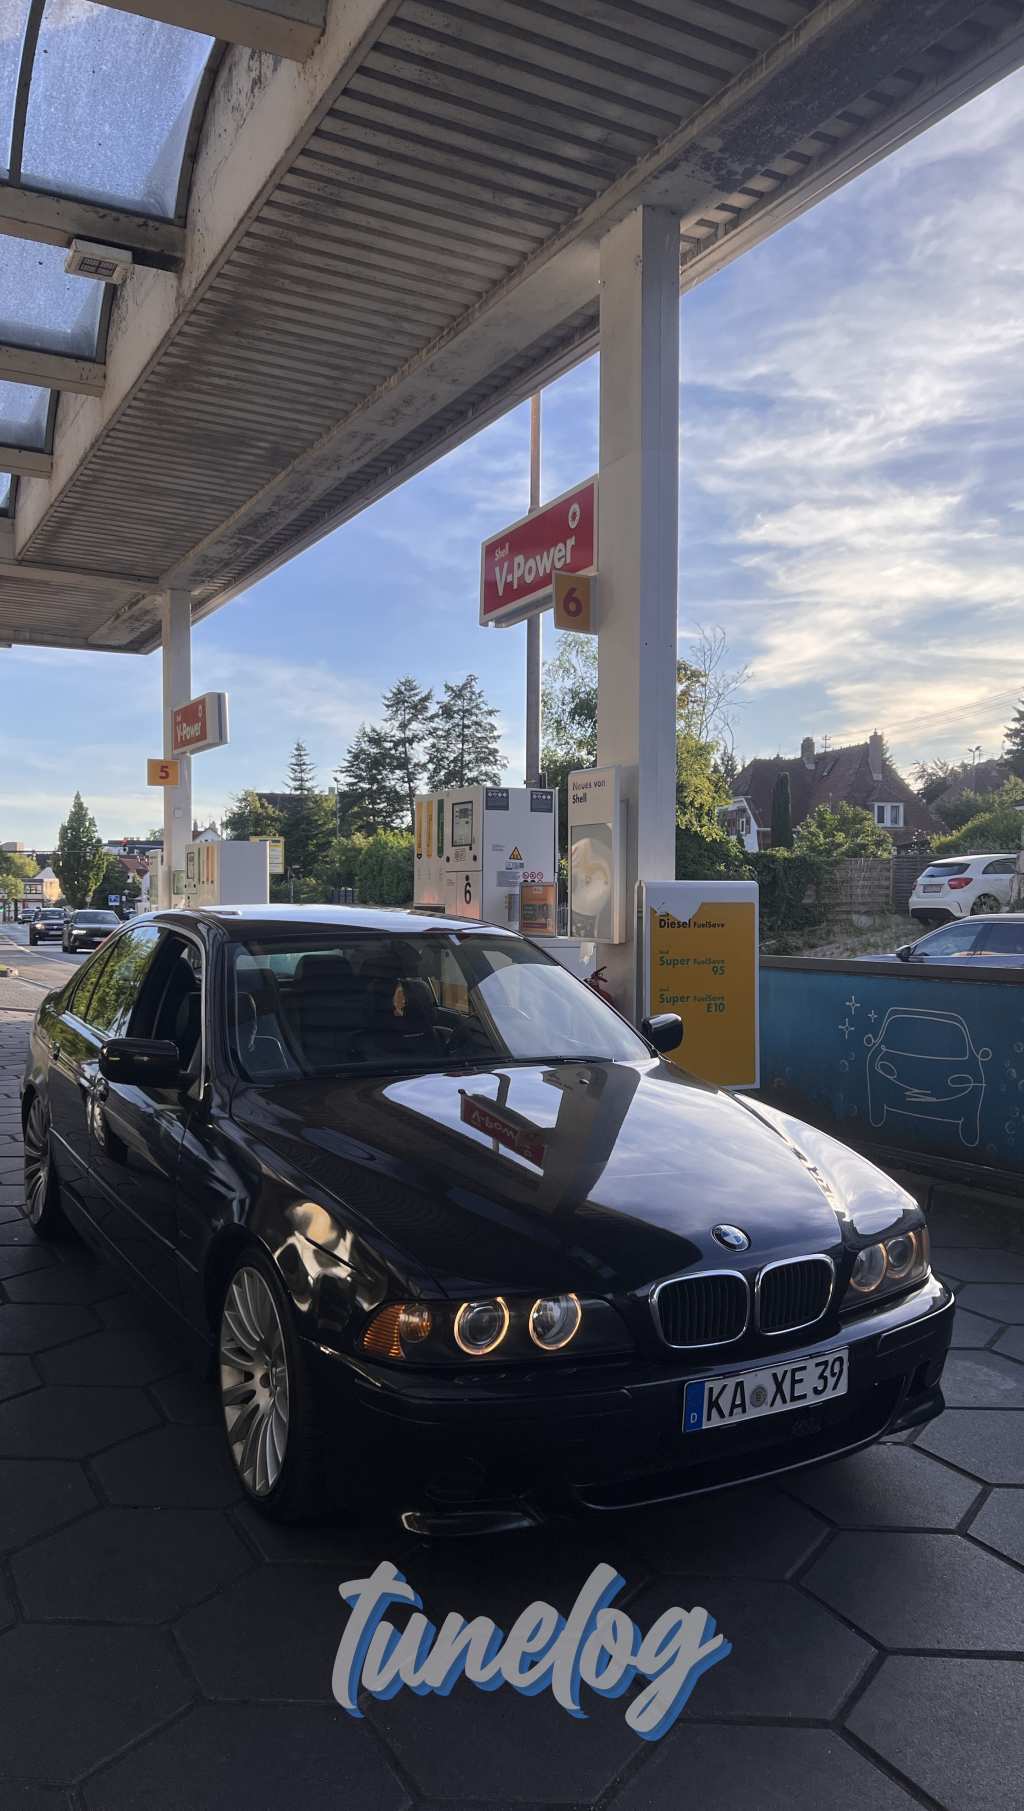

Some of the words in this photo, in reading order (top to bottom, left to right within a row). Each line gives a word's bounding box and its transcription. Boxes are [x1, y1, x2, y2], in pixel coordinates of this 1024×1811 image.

[494, 542, 510, 561] Shell
[494, 535, 576, 597] V-Power
[562, 587, 583, 618] 6
[176, 721, 202, 743] V-Power
[159, 765, 170, 780] 5
[593, 779, 606, 788] von
[572, 793, 587, 804] Shell
[464, 881, 472, 905] 6
[658, 918, 692, 929] Diesel
[658, 956, 690, 968] Super
[711, 966, 725, 976] 95
[658, 993, 690, 1006] Super
[706, 1003, 726, 1013] E10
[706, 1380, 747, 1422] KA
[769, 1365, 808, 1408] XE
[812, 1355, 845, 1396] 39
[690, 1411, 698, 1425] D
